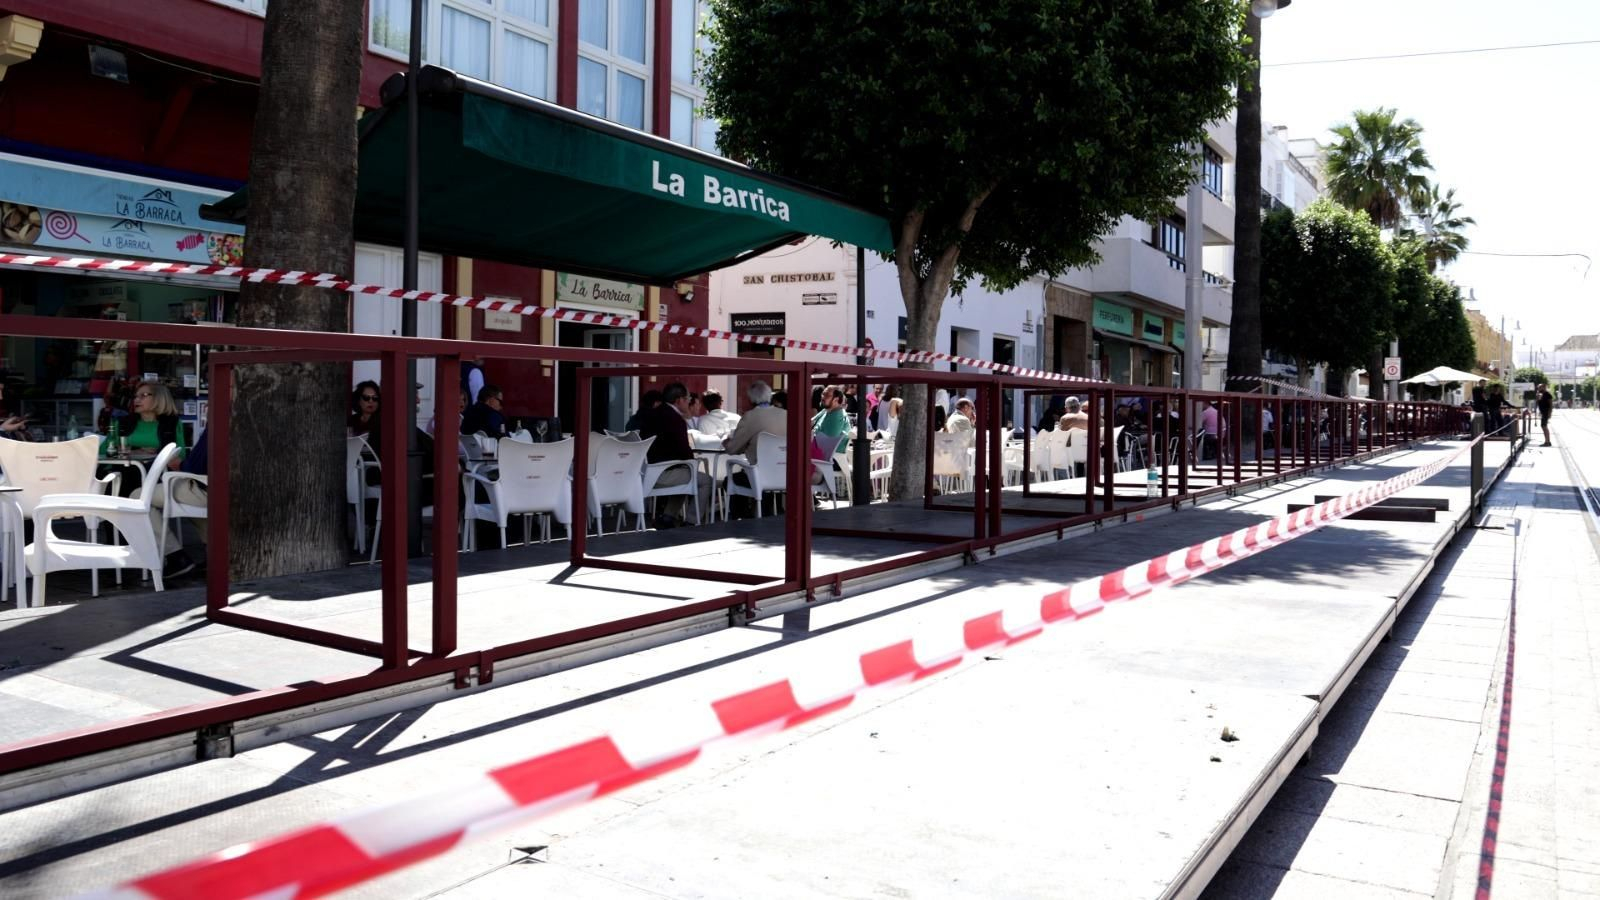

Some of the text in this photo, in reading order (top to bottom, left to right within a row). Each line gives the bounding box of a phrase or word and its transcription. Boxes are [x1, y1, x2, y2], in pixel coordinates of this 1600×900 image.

[652, 160, 790, 222] La Barrica
[116, 201, 186, 225] LA BARRACA
[102, 236, 154, 253] LA BARRACA
[571, 279, 633, 304] La Barrica
[743, 275, 764, 285] SAN
